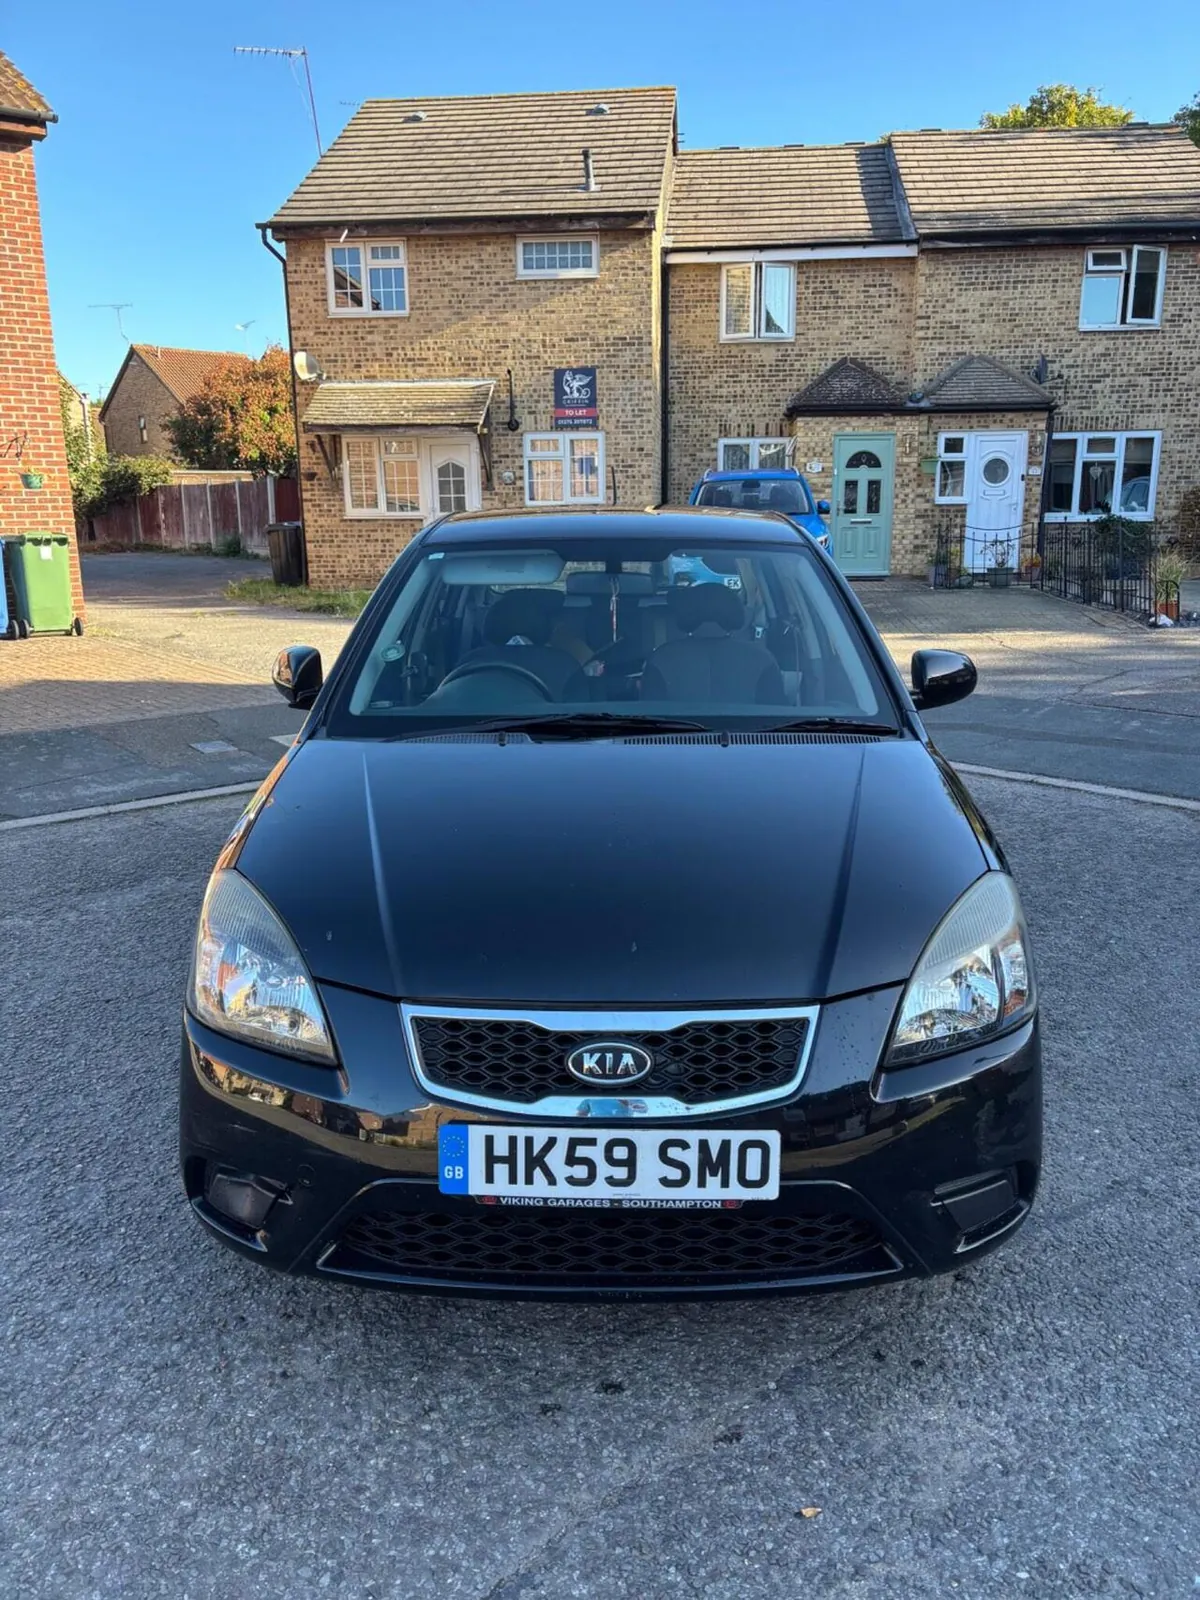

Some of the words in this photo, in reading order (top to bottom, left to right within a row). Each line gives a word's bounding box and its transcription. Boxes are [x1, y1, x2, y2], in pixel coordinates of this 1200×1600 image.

[582, 1052, 638, 1075] KIA
[484, 1134, 637, 1188] HK59
[658, 1138, 771, 1189] SMO
[444, 1165, 464, 1180] GB
[499, 1197, 544, 1206] VIKING
[547, 1198, 611, 1208] GARAGES
[622, 1199, 721, 1209] SOUTHAMPTON
